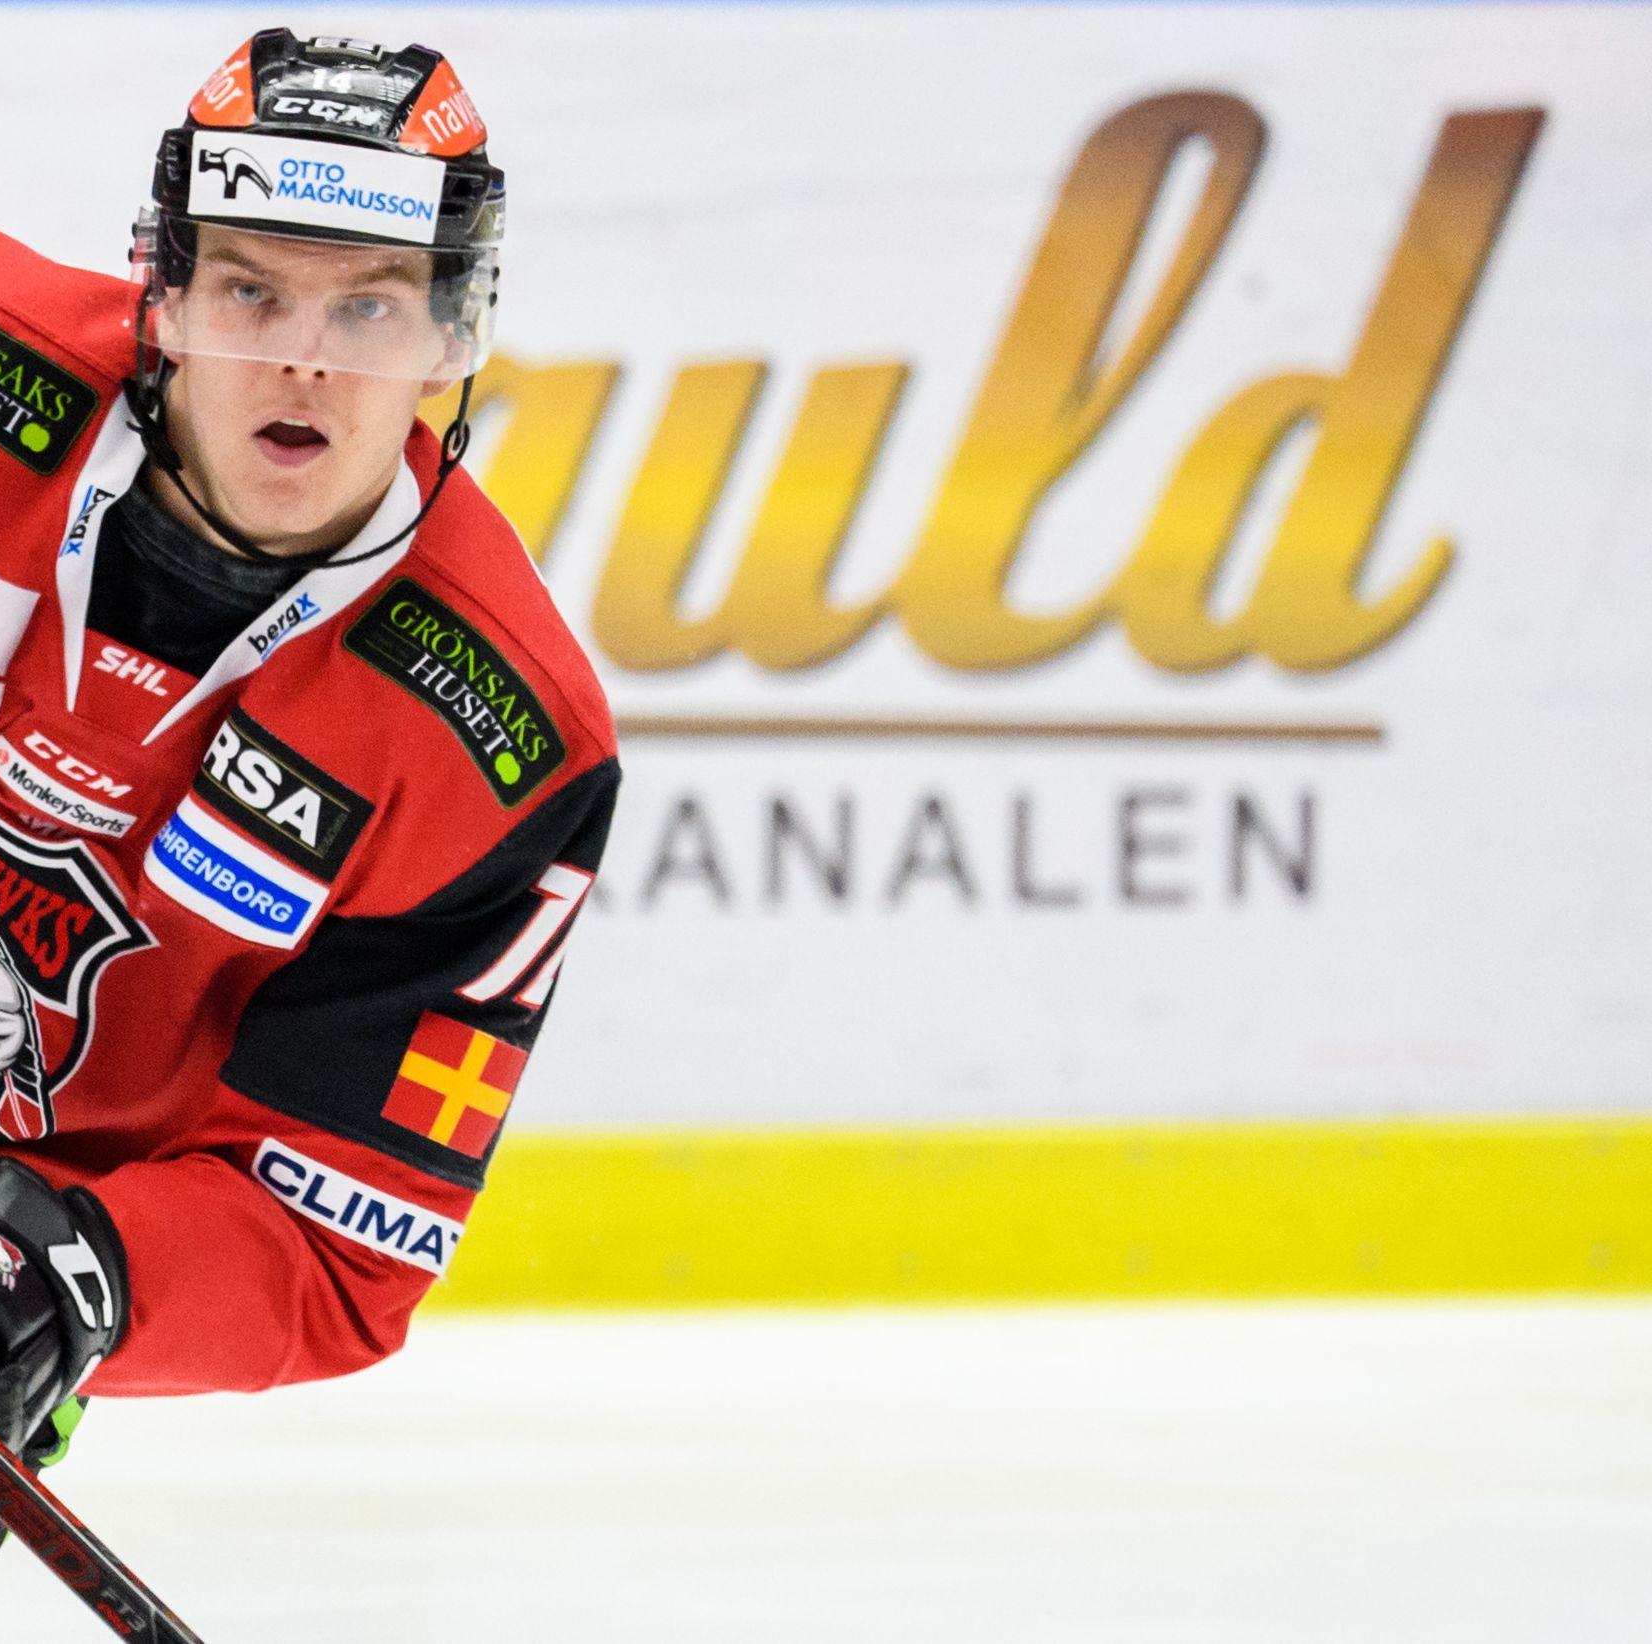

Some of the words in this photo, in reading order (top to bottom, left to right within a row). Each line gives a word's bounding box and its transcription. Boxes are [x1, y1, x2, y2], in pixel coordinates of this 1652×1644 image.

[312, 68, 352, 94] 14
[276, 182, 434, 221] MAGNUSSON
[280, 158, 346, 184] OTTO
[93, 645, 169, 697] SHL
[389, 600, 548, 763] GRÖNSAKS
[408, 653, 511, 756] HUSET
[8, 761, 127, 834] MonkeySports
[23, 730, 134, 799] CCM
[203, 720, 322, 848] RSA
[158, 825, 294, 924] HRENBORG
[591, 788, 1320, 912] ANALEN
[257, 1150, 461, 1266] CLIMA
